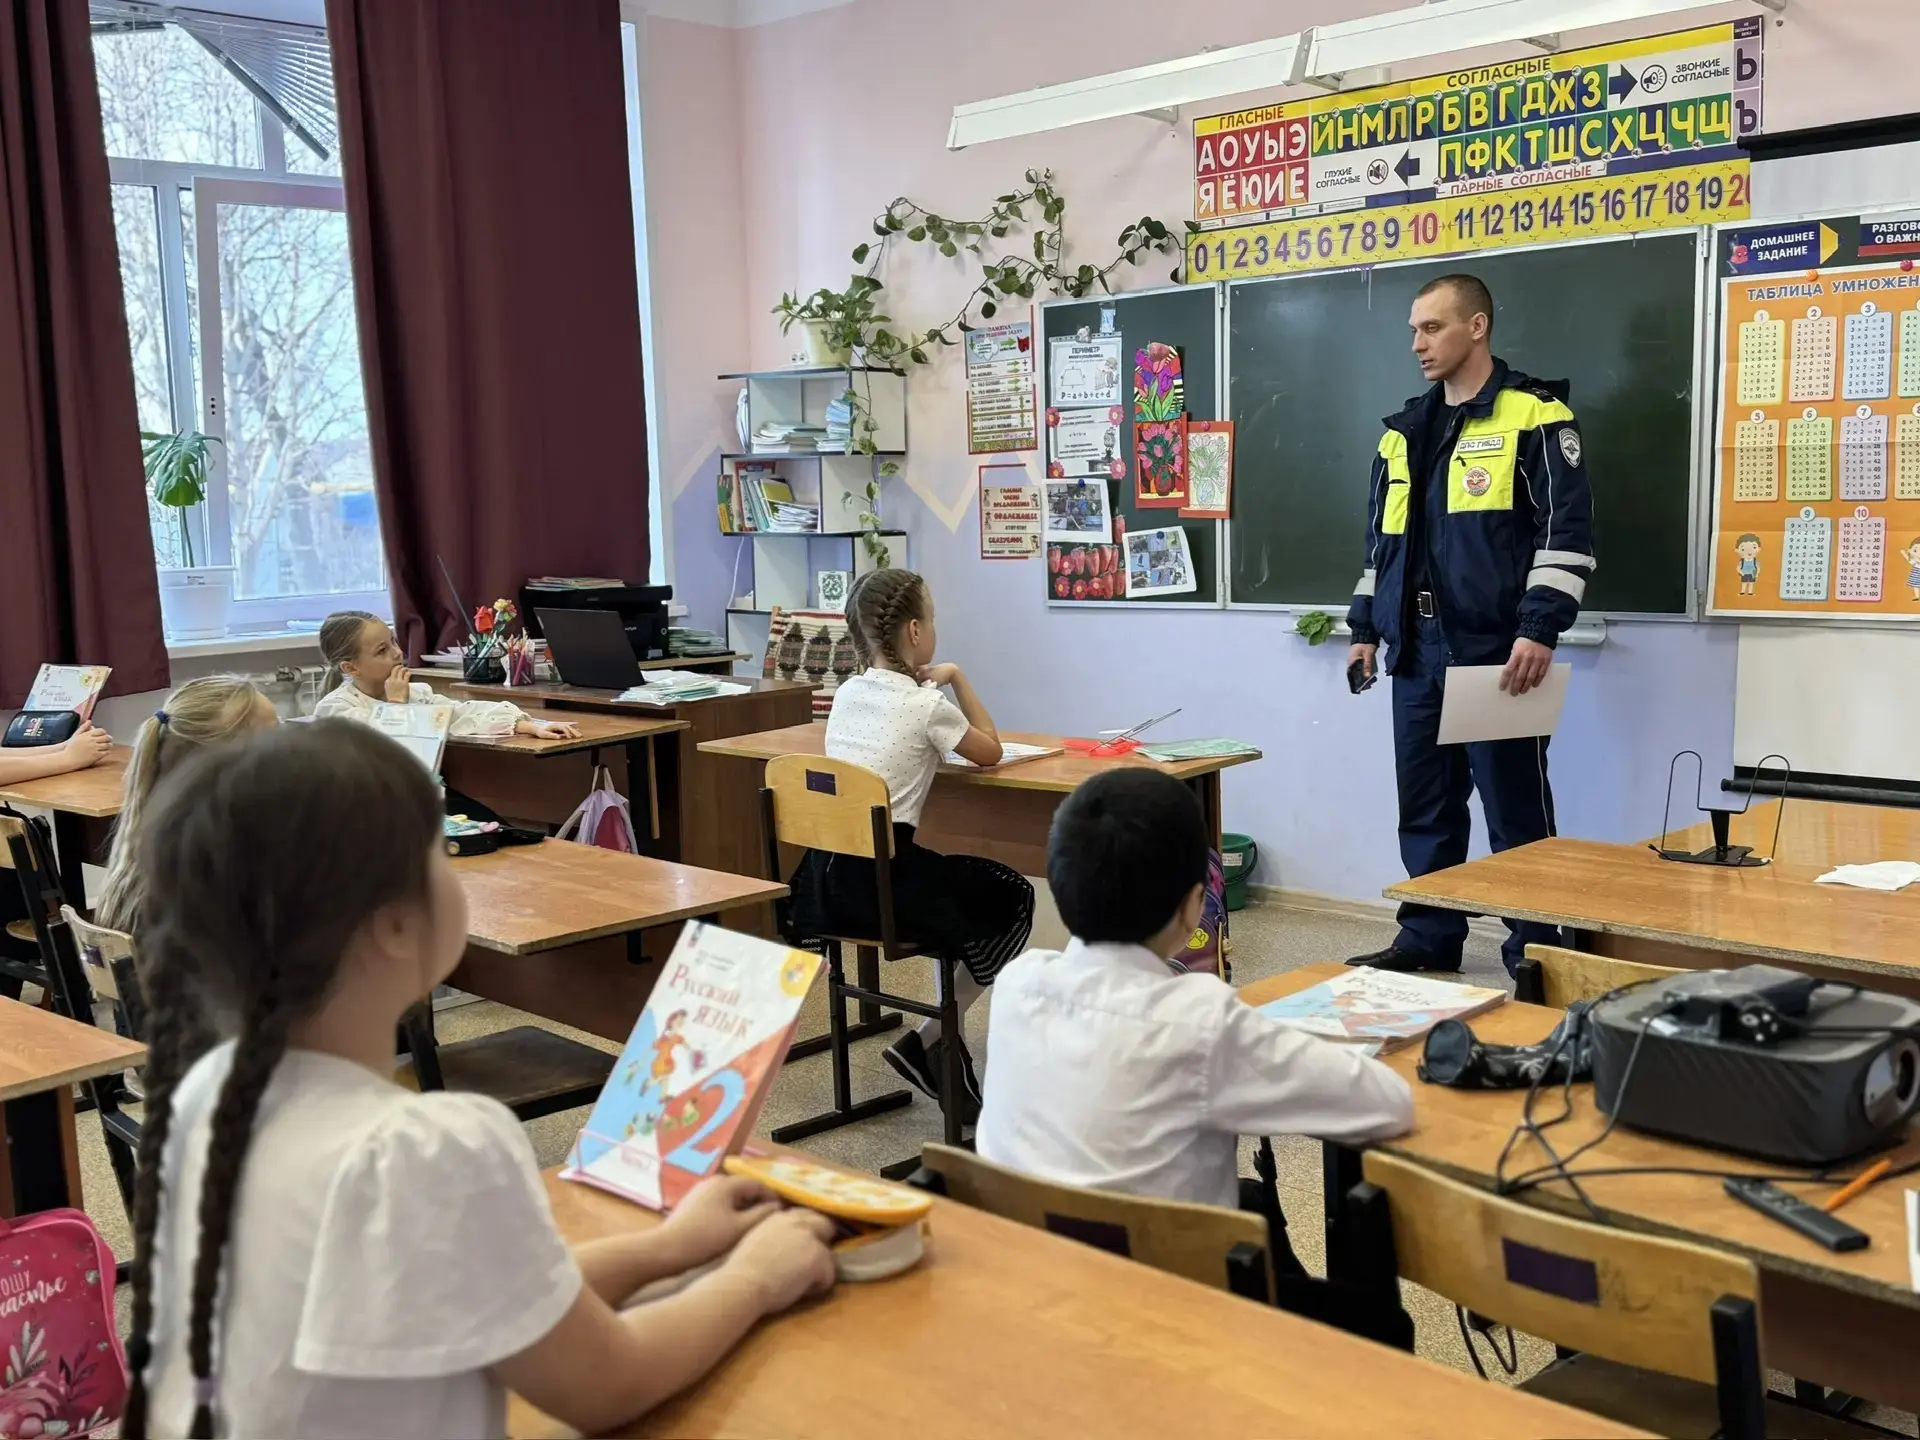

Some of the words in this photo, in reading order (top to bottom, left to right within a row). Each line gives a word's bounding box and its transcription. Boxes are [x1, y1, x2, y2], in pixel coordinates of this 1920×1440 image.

[1446, 58, 1551, 88] СОГЛАСНЫЕ
[1675, 58, 1720, 73] ЗВОНКИЕ
[1671, 67, 1730, 84] СОГЛАСНЫЕ
[1219, 106, 1284, 130] ГЛАСНЫЕ
[1315, 175, 1361, 189] СОГЛАСНЫЕ
[1324, 166, 1352, 179] ГЛУХИЕ
[1450, 179, 1504, 195] ПАРНЫЕ
[1510, 165, 1592, 187] СОГЛАСНЫЕ
[1194, 243, 1208, 273] 0
[1215, 240, 1226, 271] 1
[1233, 238, 1248, 268] 2
[1254, 235, 1269, 265] 3
[1274, 231, 1291, 262] 4
[1296, 229, 1311, 260] 5
[1317, 226, 1333, 258] 6
[1338, 223, 1355, 256] 7
[1361, 220, 1377, 251] 8
[1383, 217, 1400, 249] 9
[1408, 212, 1438, 245] 10
[1455, 207, 1474, 239] 11
[1480, 204, 1504, 236] 12
[1509, 200, 1533, 233] 13
[1538, 195, 1563, 229] 14
[1570, 192, 1594, 225] 15
[1600, 188, 1625, 222] 16
[1631, 183, 1657, 218] 17
[1663, 179, 1690, 215] 18
[1696, 176, 1723, 210] 19
[1750, 231, 1815, 250] ДОМАШНЕЕ
[1874, 234, 1884, 244] О
[1757, 246, 1808, 262] ЗАДАНИЕ
[1747, 283, 1823, 301] ТАБЛИЦА
[1832, 274, 1919, 295] УМНОЖЕН
[664, 1068, 747, 1177] 2
